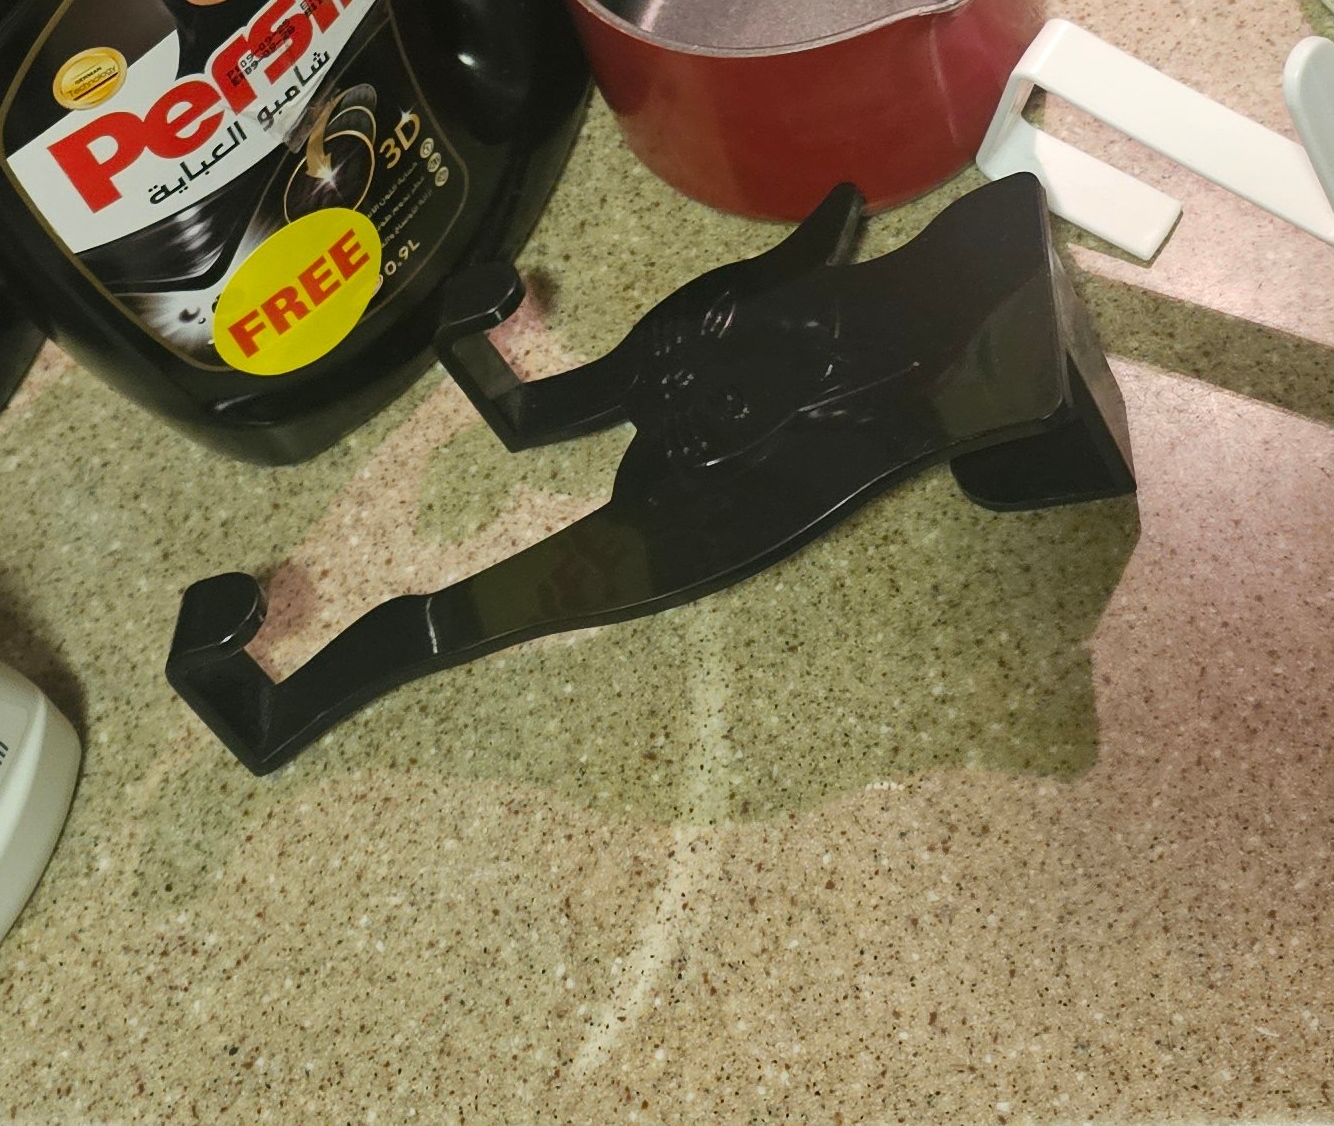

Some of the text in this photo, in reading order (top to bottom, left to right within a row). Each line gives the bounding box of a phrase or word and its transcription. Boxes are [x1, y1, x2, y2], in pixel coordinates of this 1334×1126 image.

[67, 65, 116, 97] Technology
[147, 50, 331, 206] شامبو العباية
[379, 113, 421, 169] 3D
[384, 239, 420, 276] 0.9L
[228, 229, 370, 358] FREE
